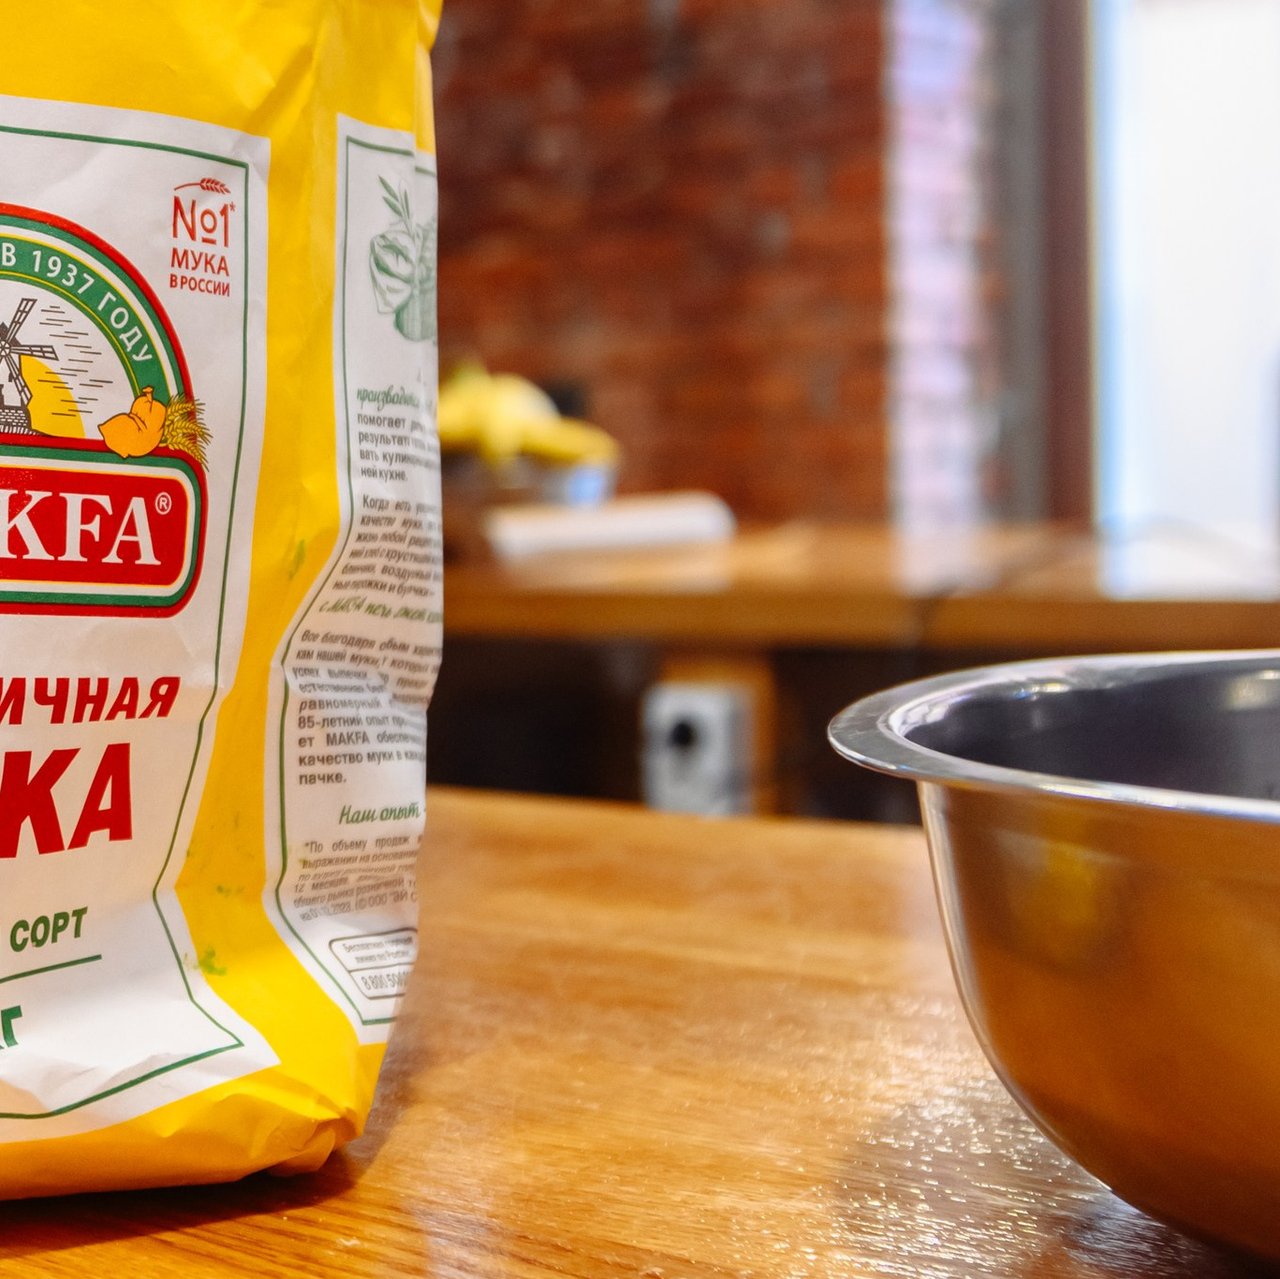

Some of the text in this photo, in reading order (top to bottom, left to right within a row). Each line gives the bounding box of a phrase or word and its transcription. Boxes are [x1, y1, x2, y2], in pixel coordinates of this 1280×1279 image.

[170, 247, 230, 277] МУКА
[169, 273, 231, 298] В РОССИИ
[0, 241, 18, 268] В
[31, 249, 96, 298] 1937
[96, 290, 154, 365] ГОДУ
[357, 413, 407, 429] помогает
[299, 697, 382, 713] равномерный
[298, 736, 315, 748] ет
[326, 730, 371, 747] MAKFA
[298, 751, 364, 767] качество
[366, 750, 395, 765] муки
[298, 772, 347, 785] пачке.
[338, 803, 377, 825] Наш
[9, 906, 88, 953] СОРТ
